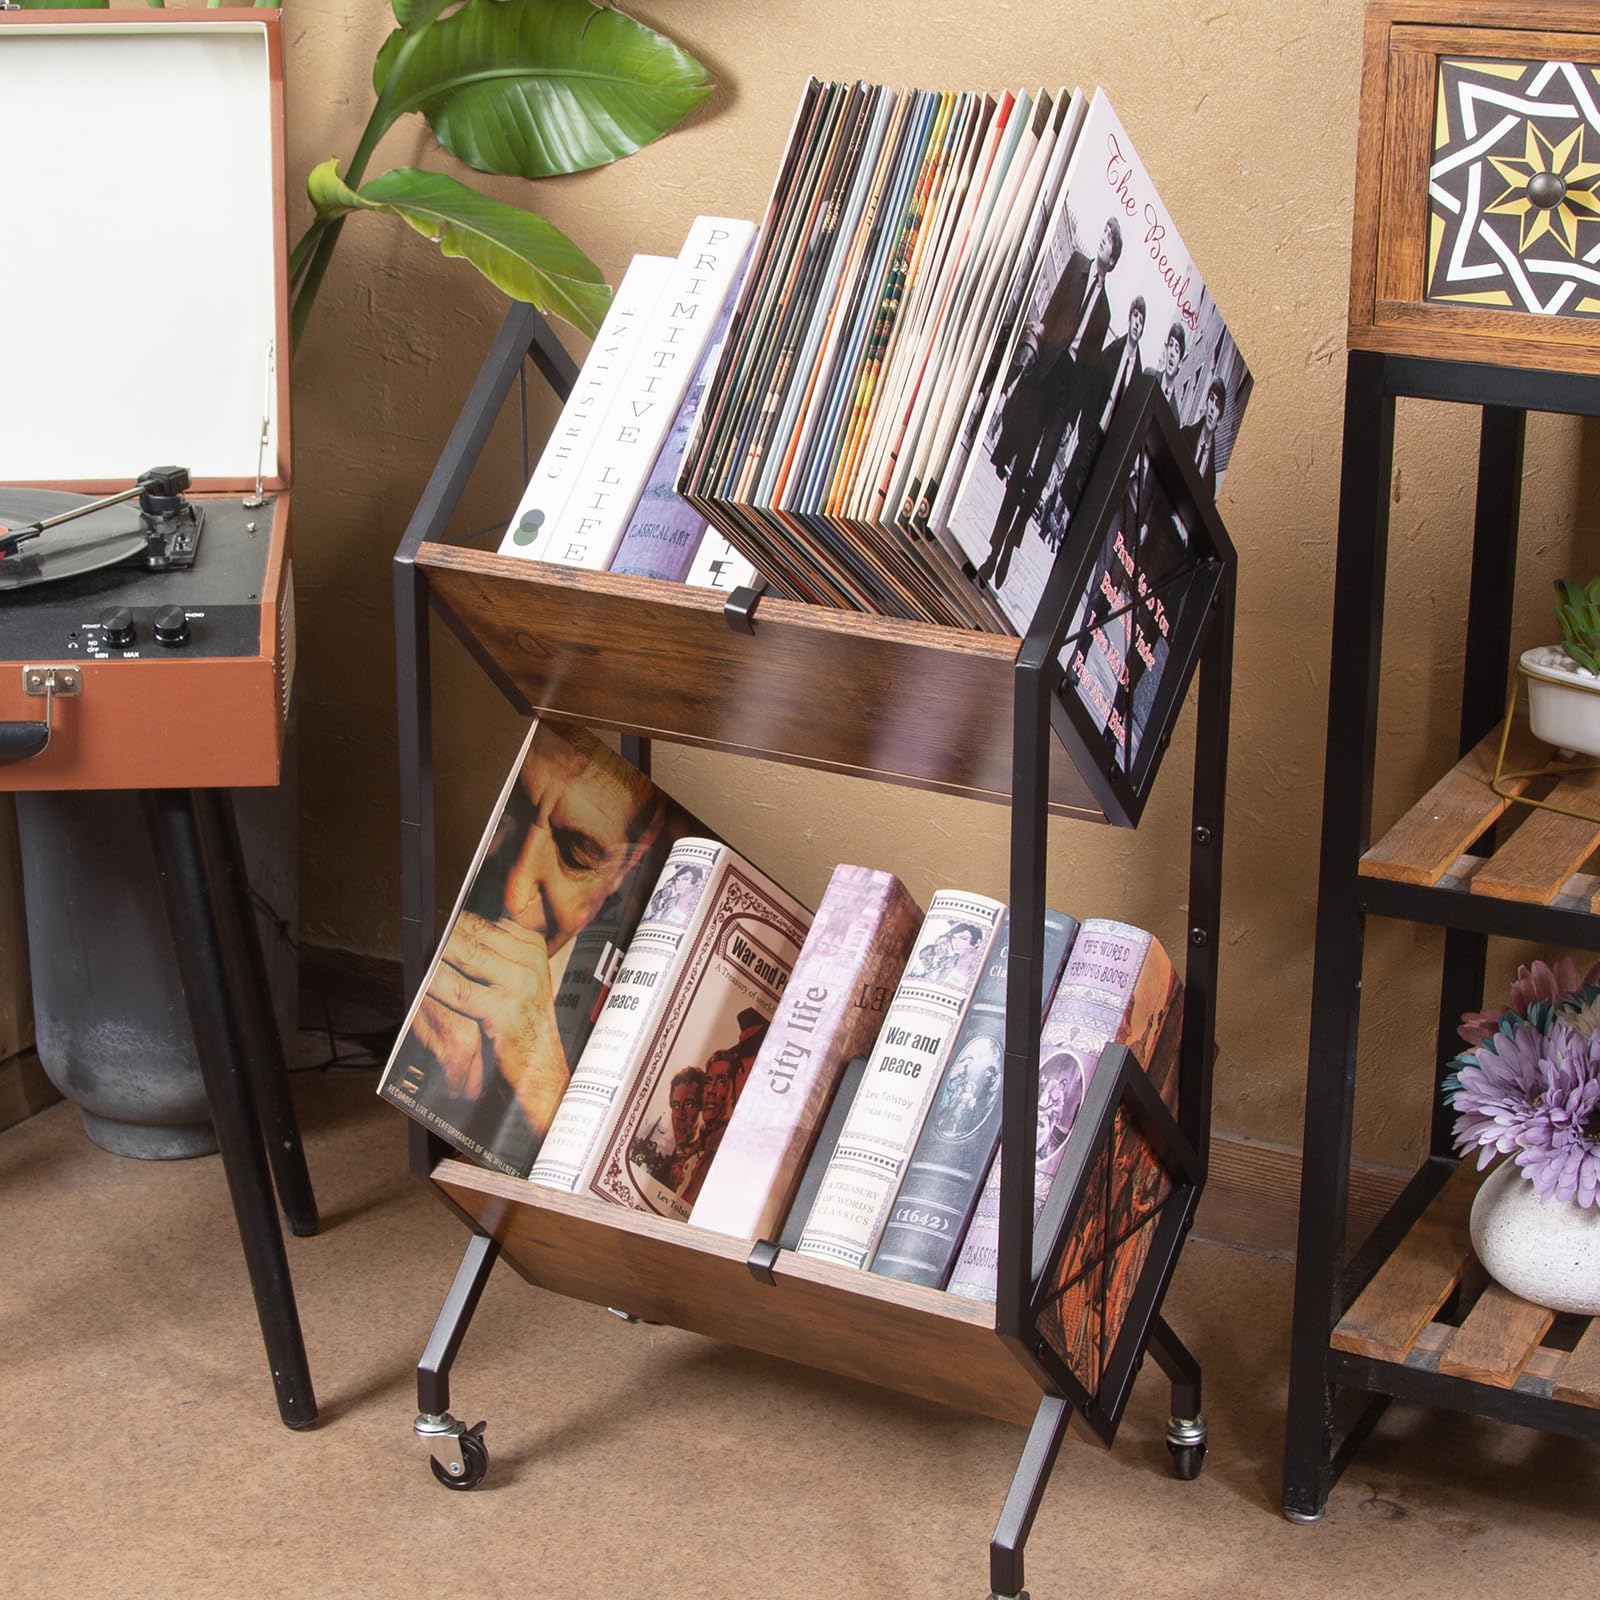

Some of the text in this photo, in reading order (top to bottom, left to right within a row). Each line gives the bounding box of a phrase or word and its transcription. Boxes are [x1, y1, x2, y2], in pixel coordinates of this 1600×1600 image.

[1106, 133, 1199, 331] The Beatles
[547, 307, 636, 479] CHRISTIANE
[561, 230, 729, 562] PRIMITIVE LIFE
[668, 529, 691, 547] ART
[731, 935, 757, 967] War
[754, 957, 779, 986] and
[632, 970, 659, 988] and
[715, 963, 722, 971] A
[721, 967, 749, 994] Treasury
[748, 990, 756, 1000] of
[606, 994, 640, 1010] peace
[768, 986, 828, 1095] city life
[885, 1026, 941, 1055] War and
[879, 1056, 922, 1078] peace
[881, 1091, 914, 1110] Tolstoy
[387, 1084, 416, 1108] RECORDED
[415, 1103, 428, 1117] LIVE
[427, 1112, 436, 1121] AT
[434, 1116, 475, 1150] PERFORMANCES
[474, 1144, 484, 1154] OF
[656, 1191, 668, 1205] Lev
[896, 1208, 949, 1231] (1642)
[964, 1245, 998, 1270] CLASSIC
